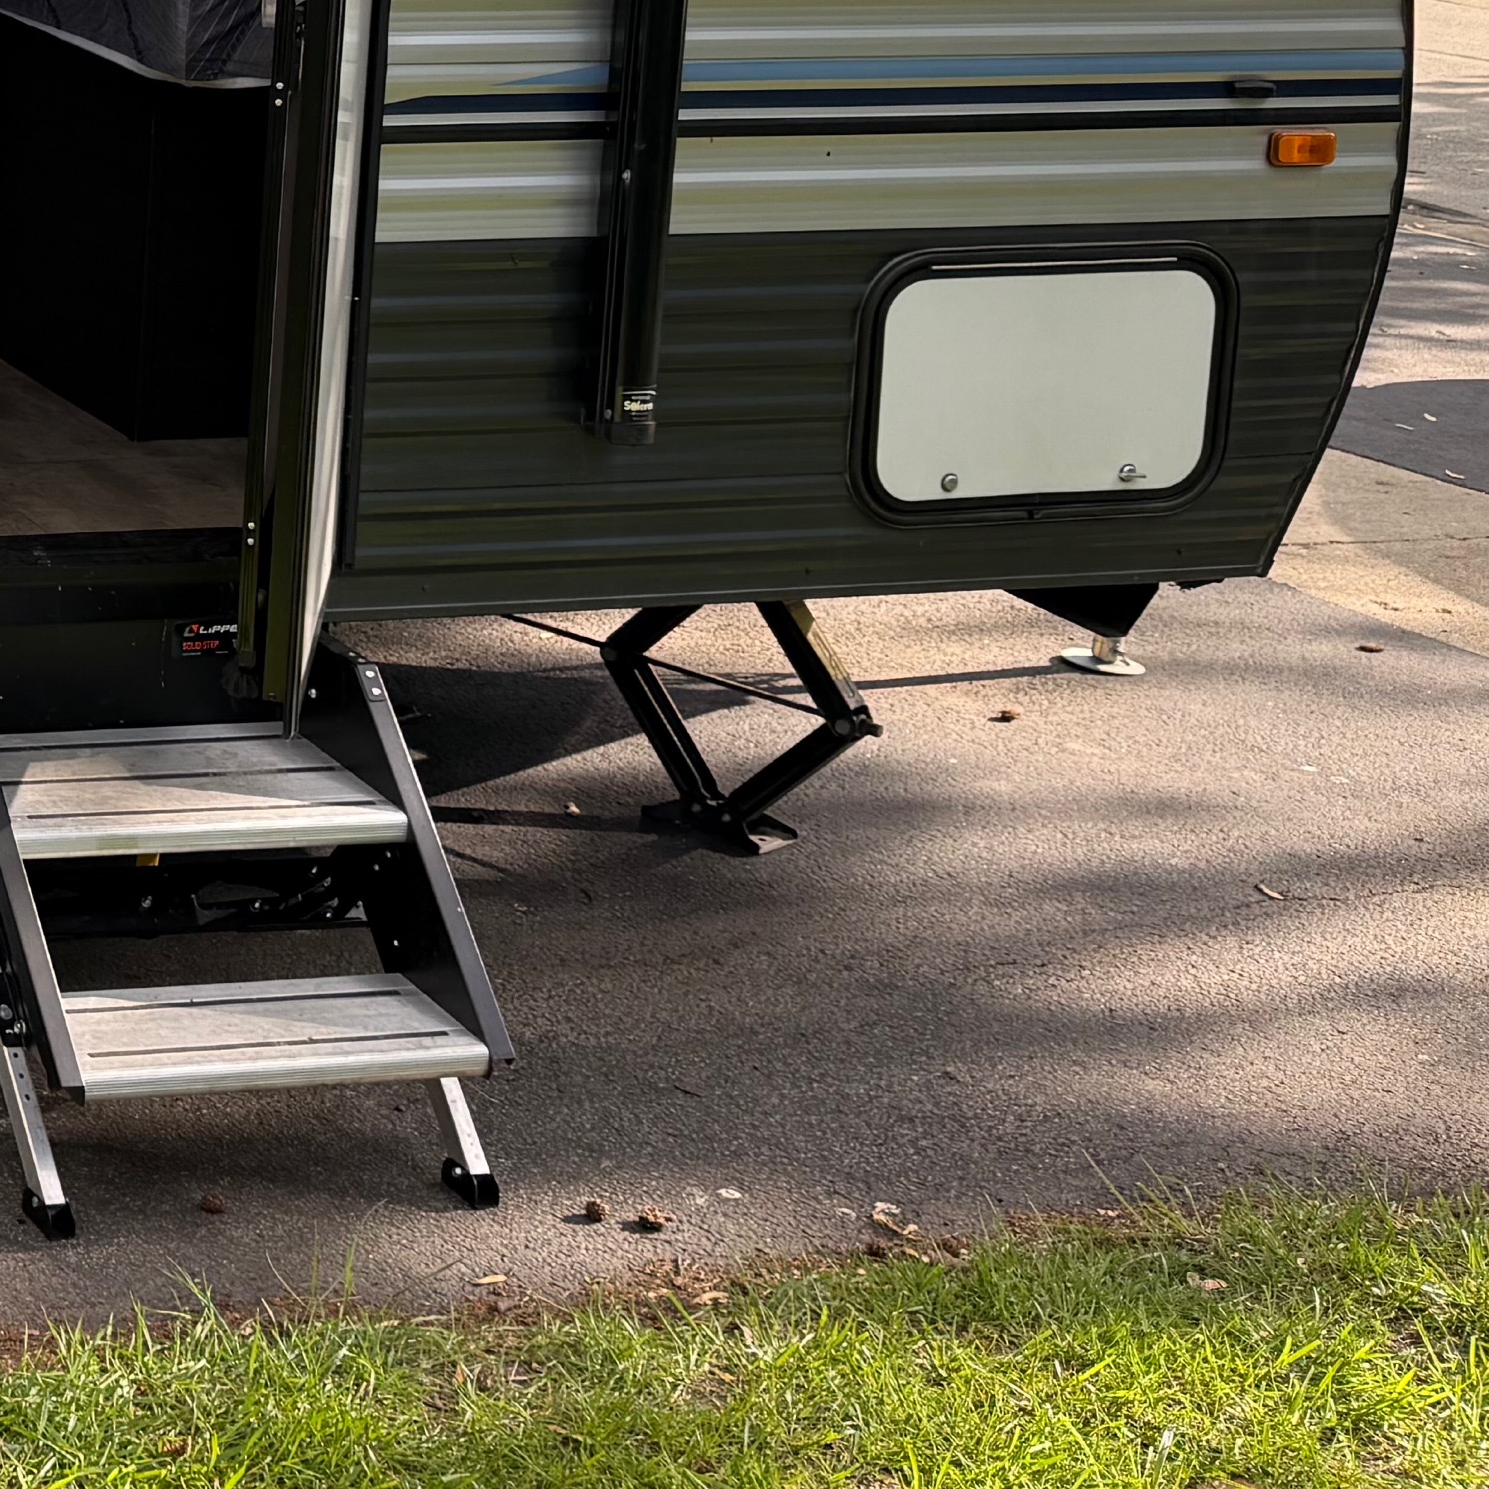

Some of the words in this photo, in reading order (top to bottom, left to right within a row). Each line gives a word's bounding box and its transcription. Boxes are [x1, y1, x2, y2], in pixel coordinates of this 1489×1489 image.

[199, 624, 238, 634] LIPPE
[182, 641, 202, 651] SOLID
[203, 640, 220, 650] STEP
